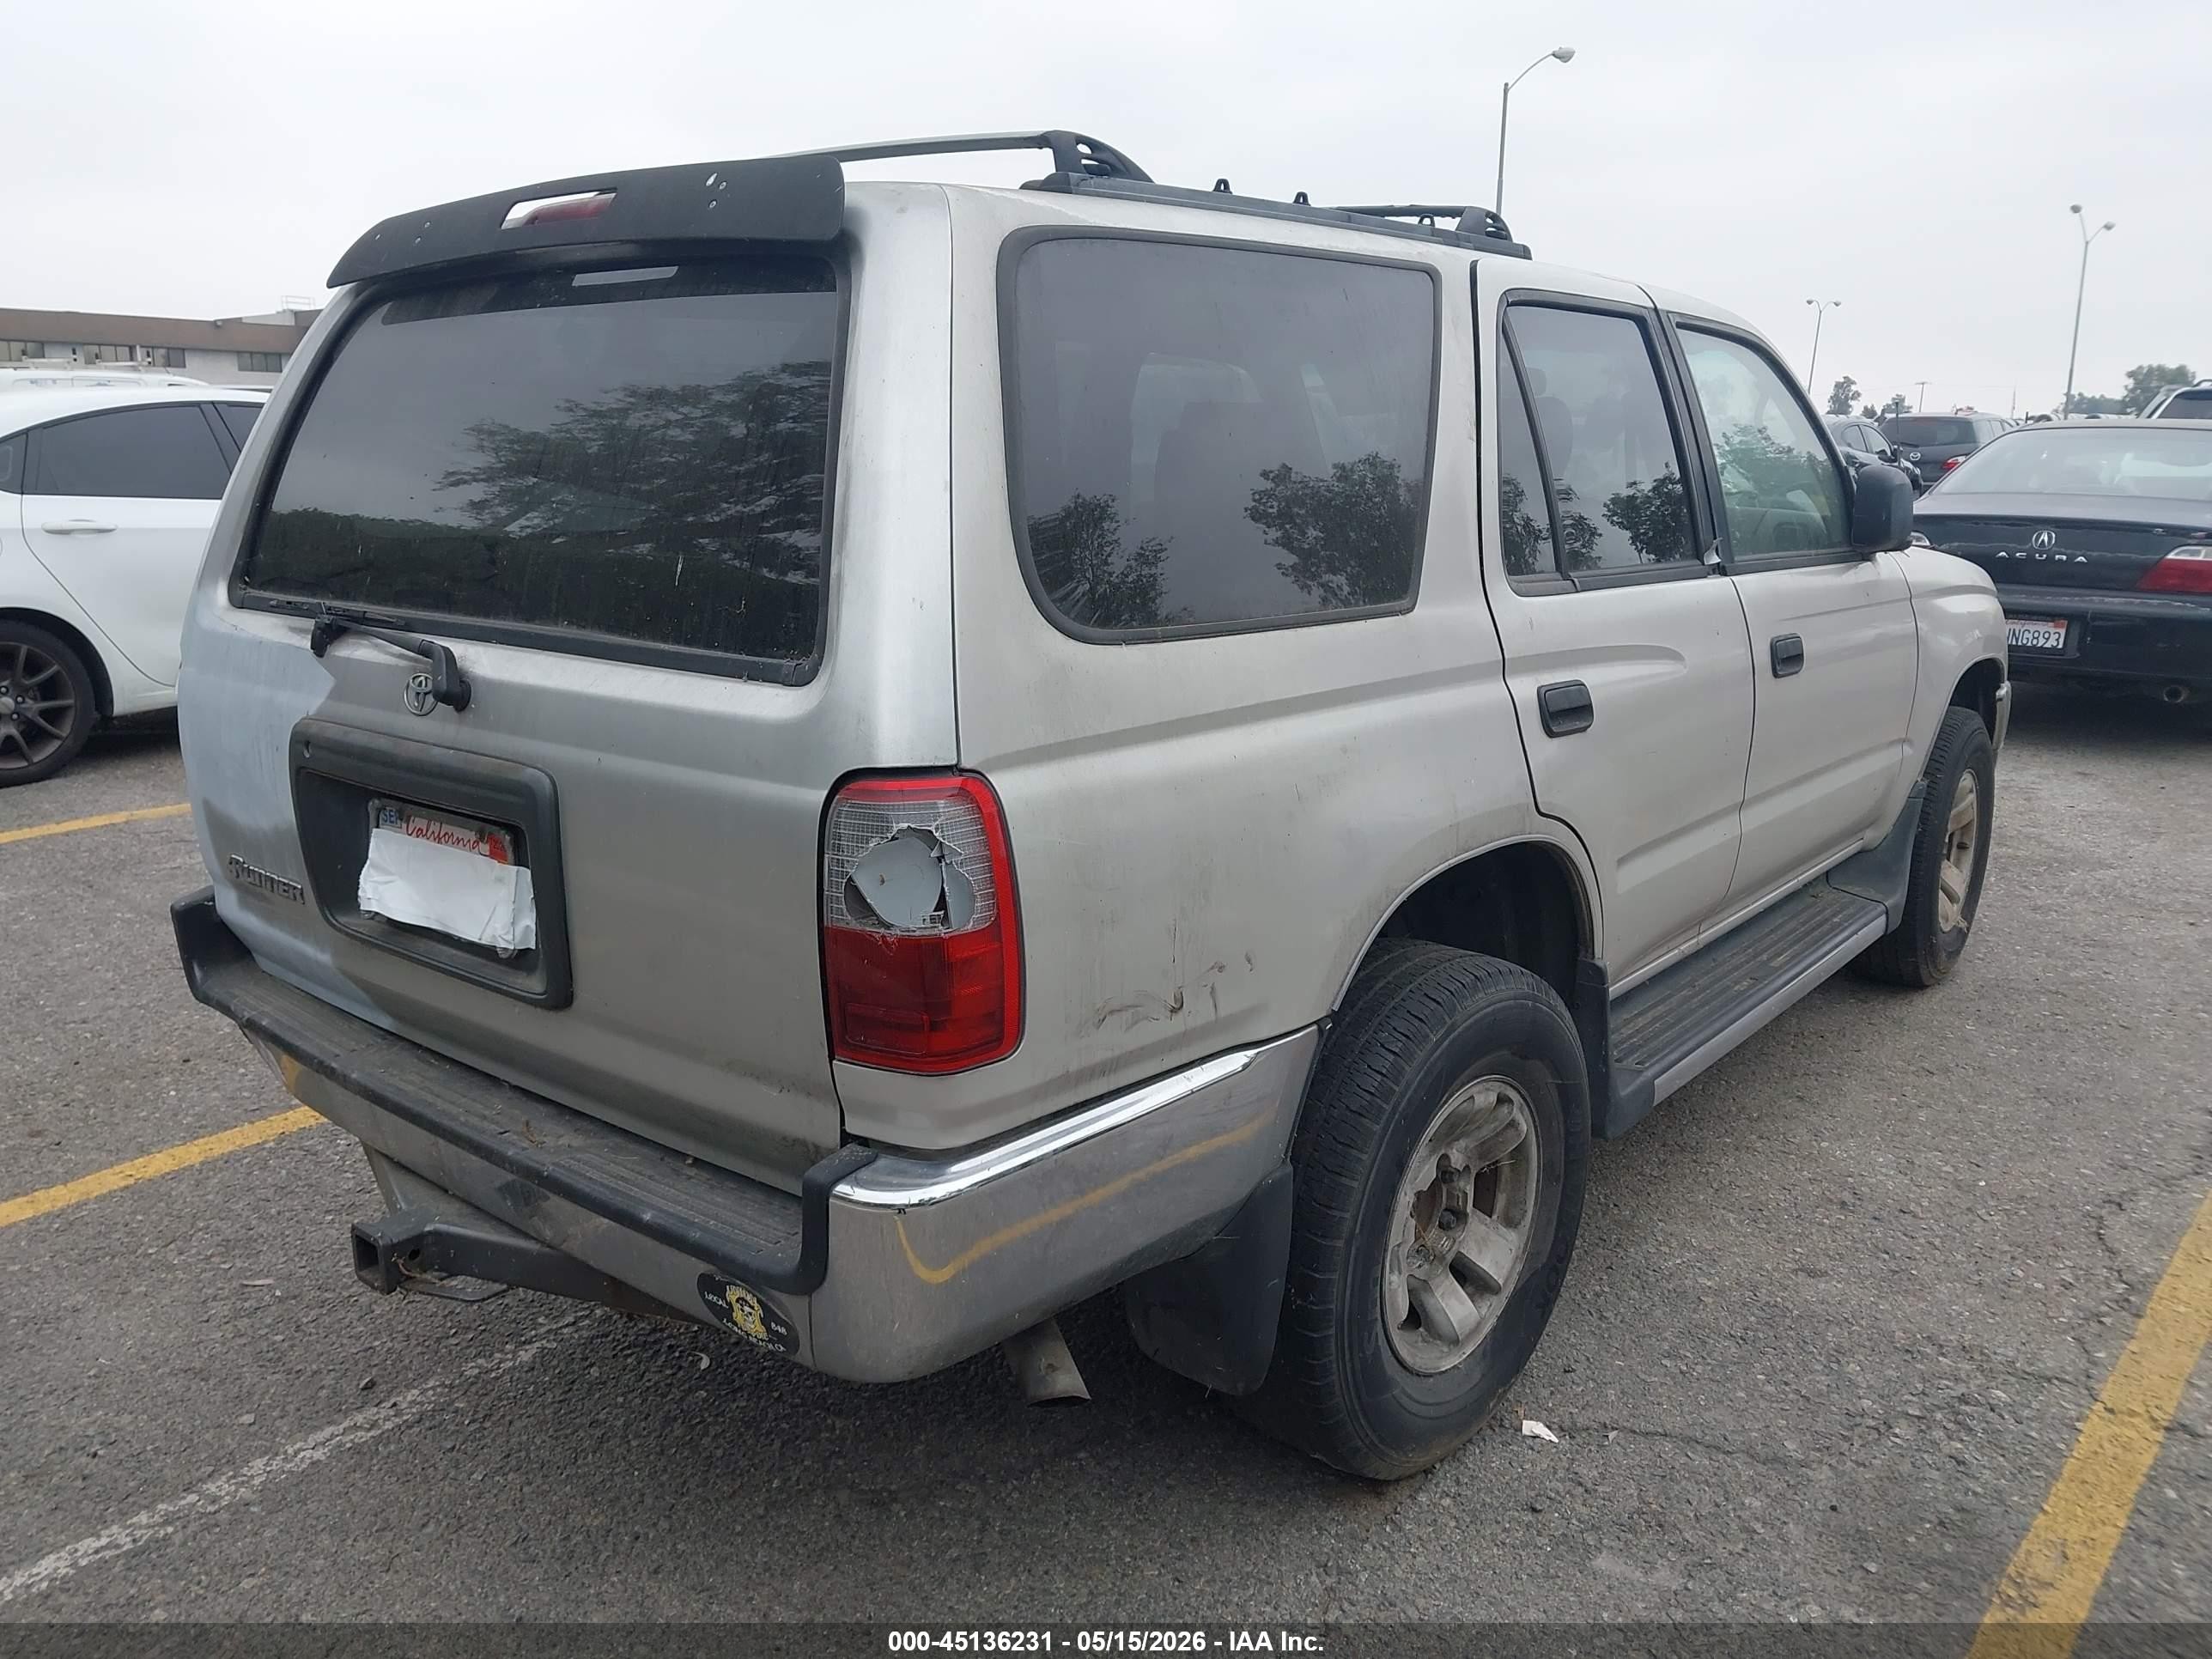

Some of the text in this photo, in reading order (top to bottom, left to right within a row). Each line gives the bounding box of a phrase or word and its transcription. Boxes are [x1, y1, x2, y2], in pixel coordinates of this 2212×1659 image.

[1995, 550, 2088, 563] ACURA
[2007, 628, 2062, 647] NG893
[405, 814, 482, 853] California
